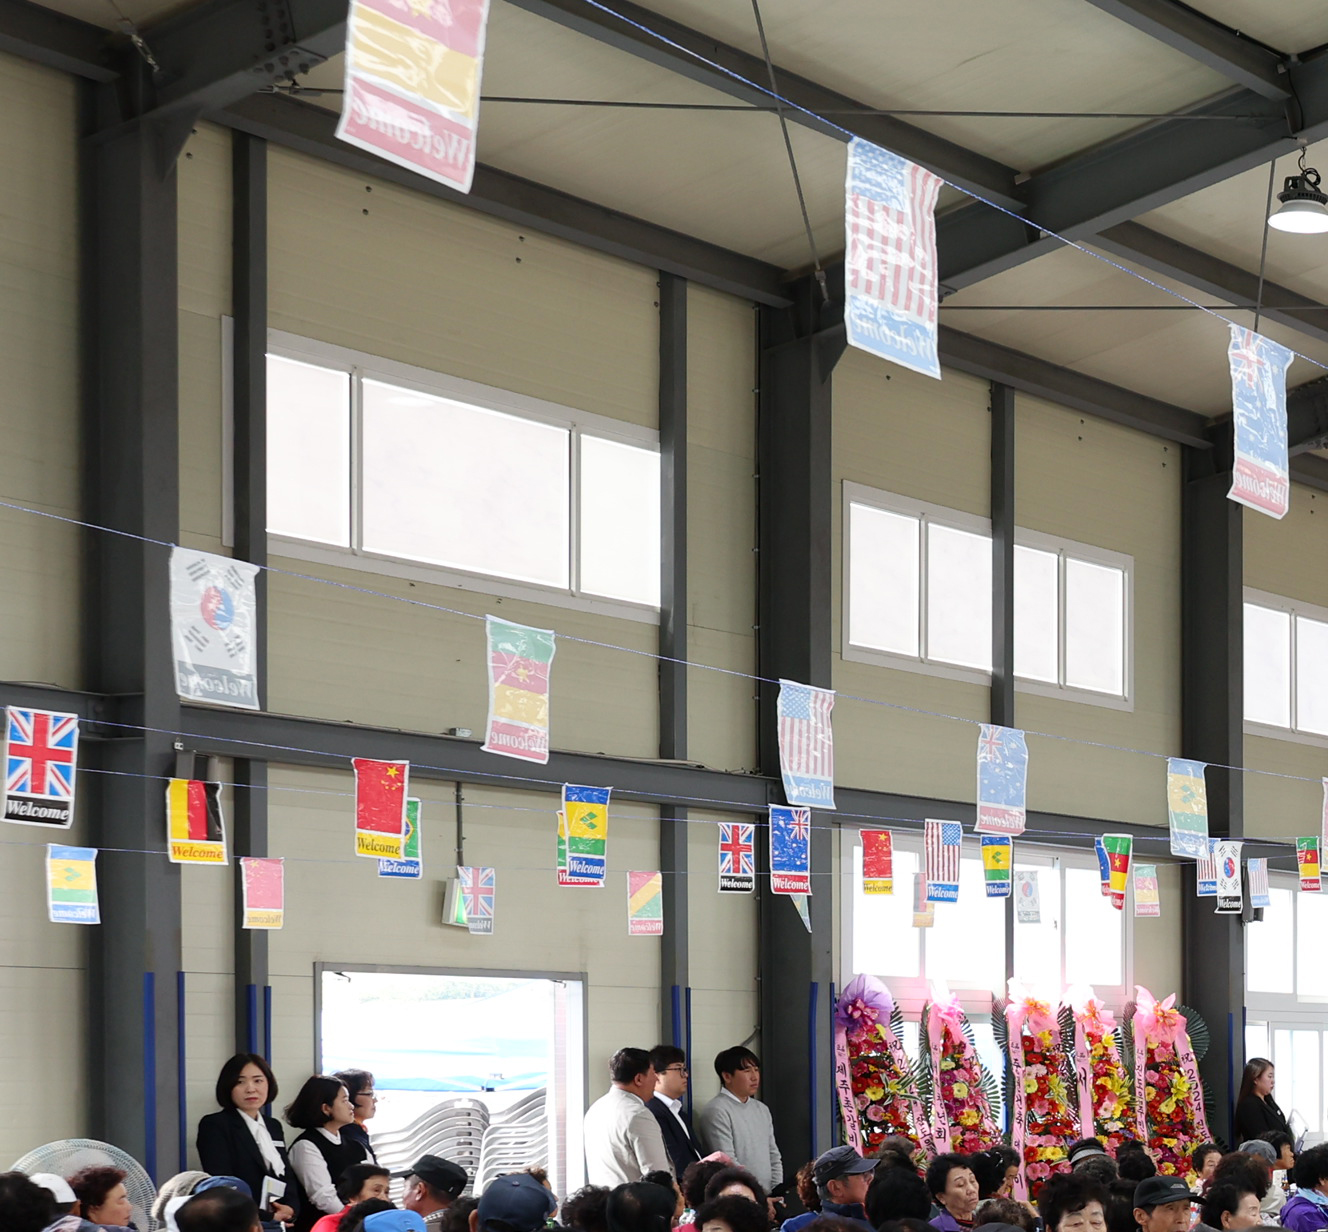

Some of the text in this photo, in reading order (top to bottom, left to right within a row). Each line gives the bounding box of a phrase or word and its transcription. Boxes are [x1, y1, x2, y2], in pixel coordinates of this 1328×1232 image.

[6, 798, 70, 822] Welcome
[171, 845, 224, 860] Welcome
[357, 835, 401, 856] Welcome
[569, 857, 606, 876] Welcome
[721, 877, 753, 891] Welcome
[773, 877, 809, 892] Welcome
[928, 884, 958, 900] Welcome
